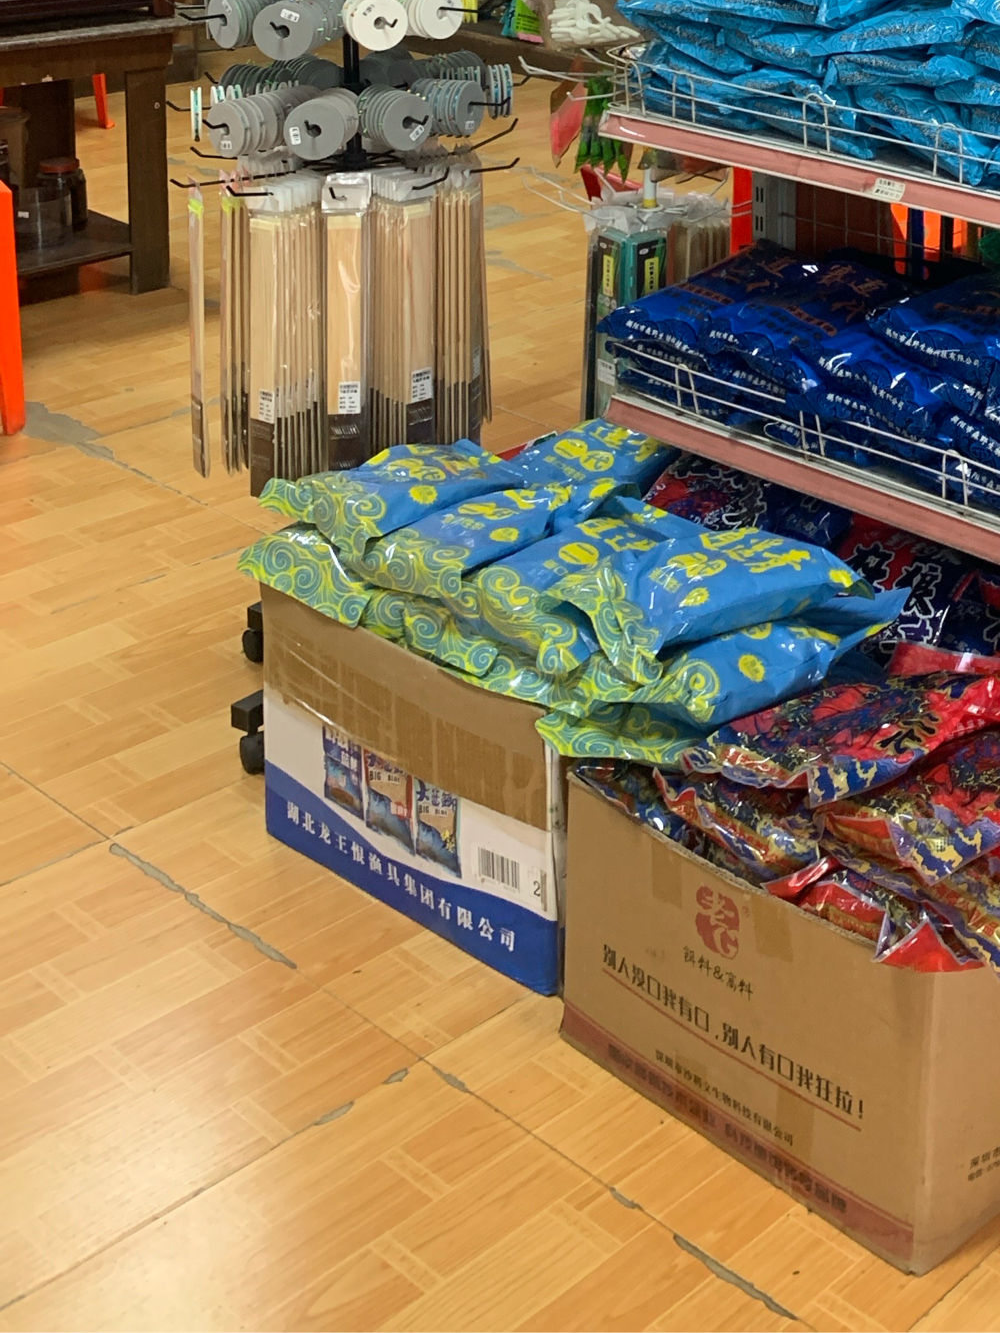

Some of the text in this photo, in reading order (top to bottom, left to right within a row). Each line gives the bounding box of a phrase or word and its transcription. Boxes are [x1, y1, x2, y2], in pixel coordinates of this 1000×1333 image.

[286, 798, 517, 954] 湖北龙王恨渔具集团有限公司
